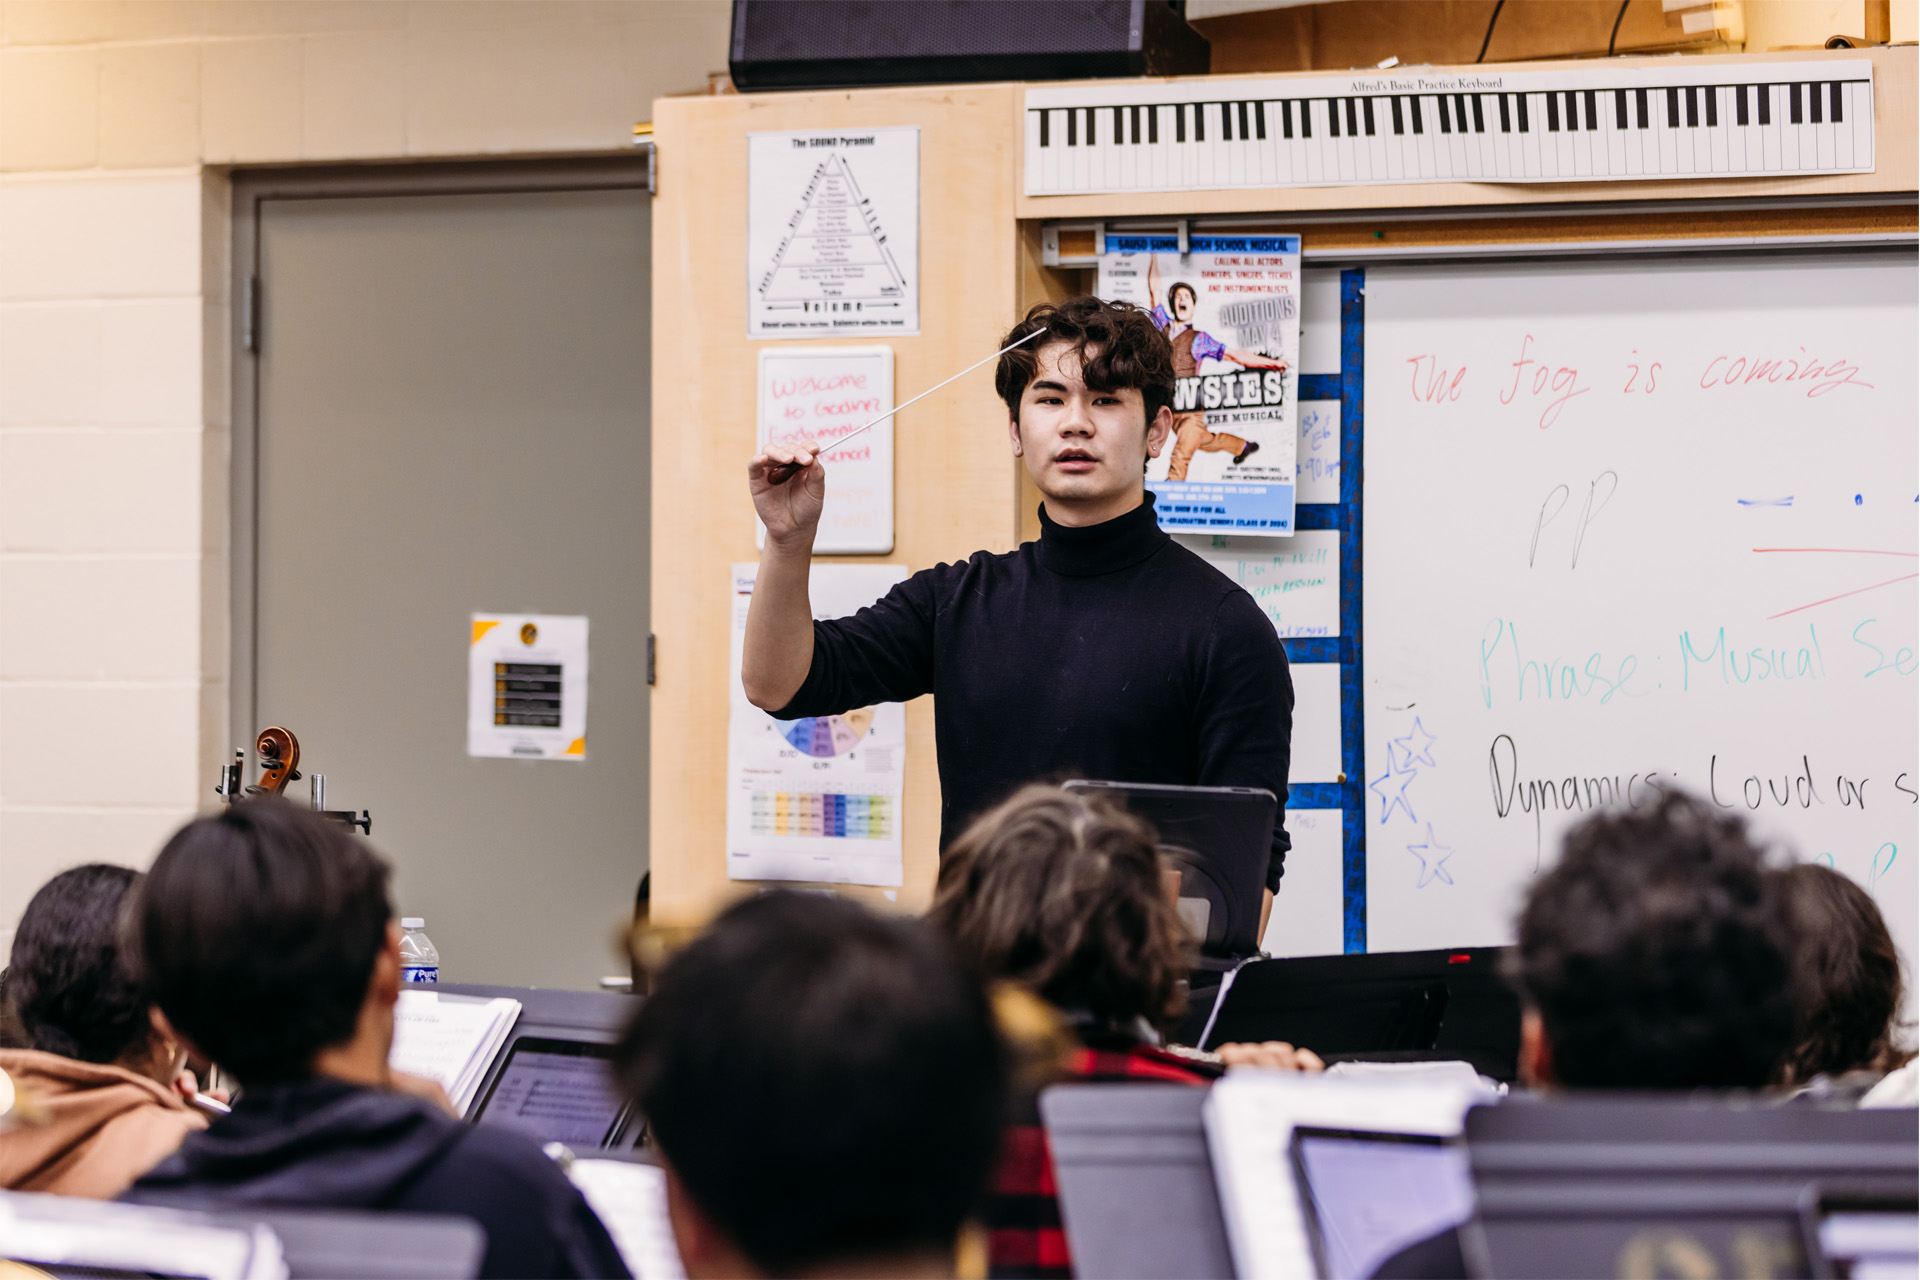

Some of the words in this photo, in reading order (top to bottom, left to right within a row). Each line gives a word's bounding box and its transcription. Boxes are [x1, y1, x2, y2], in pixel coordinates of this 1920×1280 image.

[1351, 81, 1387, 92] Alfred's
[1390, 80, 1415, 91] Basic
[1418, 79, 1456, 90] Practice
[1458, 77, 1503, 91] Keyboard
[793, 138, 806, 148] The
[810, 138, 836, 147] SOUND
[840, 136, 874, 148] Pyramid
[861, 198, 887, 245] Pitch
[1150, 239, 1178, 250] SUMM
[1215, 239, 1247, 251] SCHOOL
[1250, 239, 1288, 251] MUSICAL
[1214, 257, 1240, 266] CALLING
[1244, 257, 1254, 266] ALL
[1257, 257, 1283, 266] ACTORS
[1208, 285, 1220, 293] AND
[1224, 285, 1289, 294] INSTRUMENTALISTS
[803, 301, 862, 312] Volume
[1220, 295, 1295, 327] AUDITIONS
[1238, 325, 1267, 349] MAY
[1271, 322, 1282, 348] 4
[772, 374, 867, 399] Welcome
[1175, 370, 1283, 410] WSIES
[1408, 354, 1466, 403] The
[1500, 334, 1590, 429] fog
[1624, 350, 1662, 394] is
[1700, 347, 1874, 398] coming
[784, 405, 805, 419] to
[1206, 413, 1228, 424] THE
[1233, 410, 1283, 422] MUSICAL
[1679, 623, 1825, 691] Musical
[1710, 755, 1825, 809] Loud
[1837, 775, 1870, 810] or
